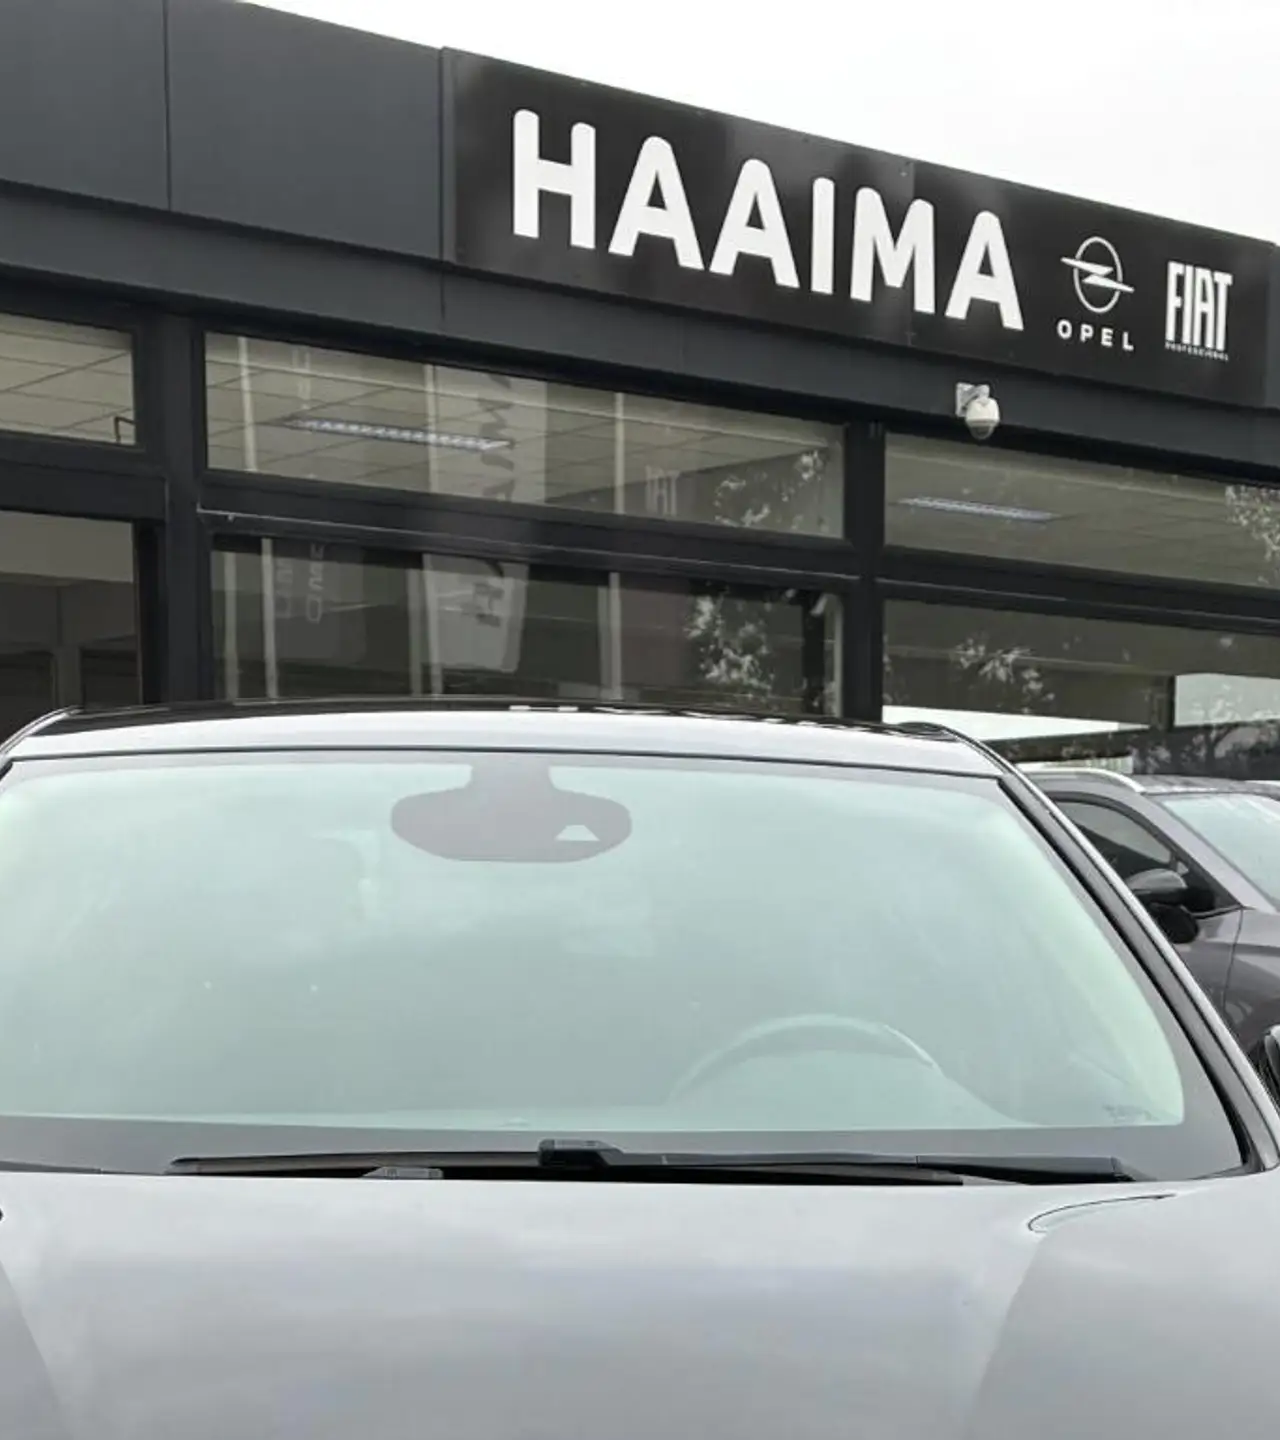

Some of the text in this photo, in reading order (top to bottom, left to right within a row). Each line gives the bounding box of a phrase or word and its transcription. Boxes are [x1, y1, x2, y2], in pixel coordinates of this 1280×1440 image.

[513, 108, 1024, 331] HAAIMA
[1056, 319, 1135, 352] OPEL
[1165, 260, 1233, 351] FIAT
